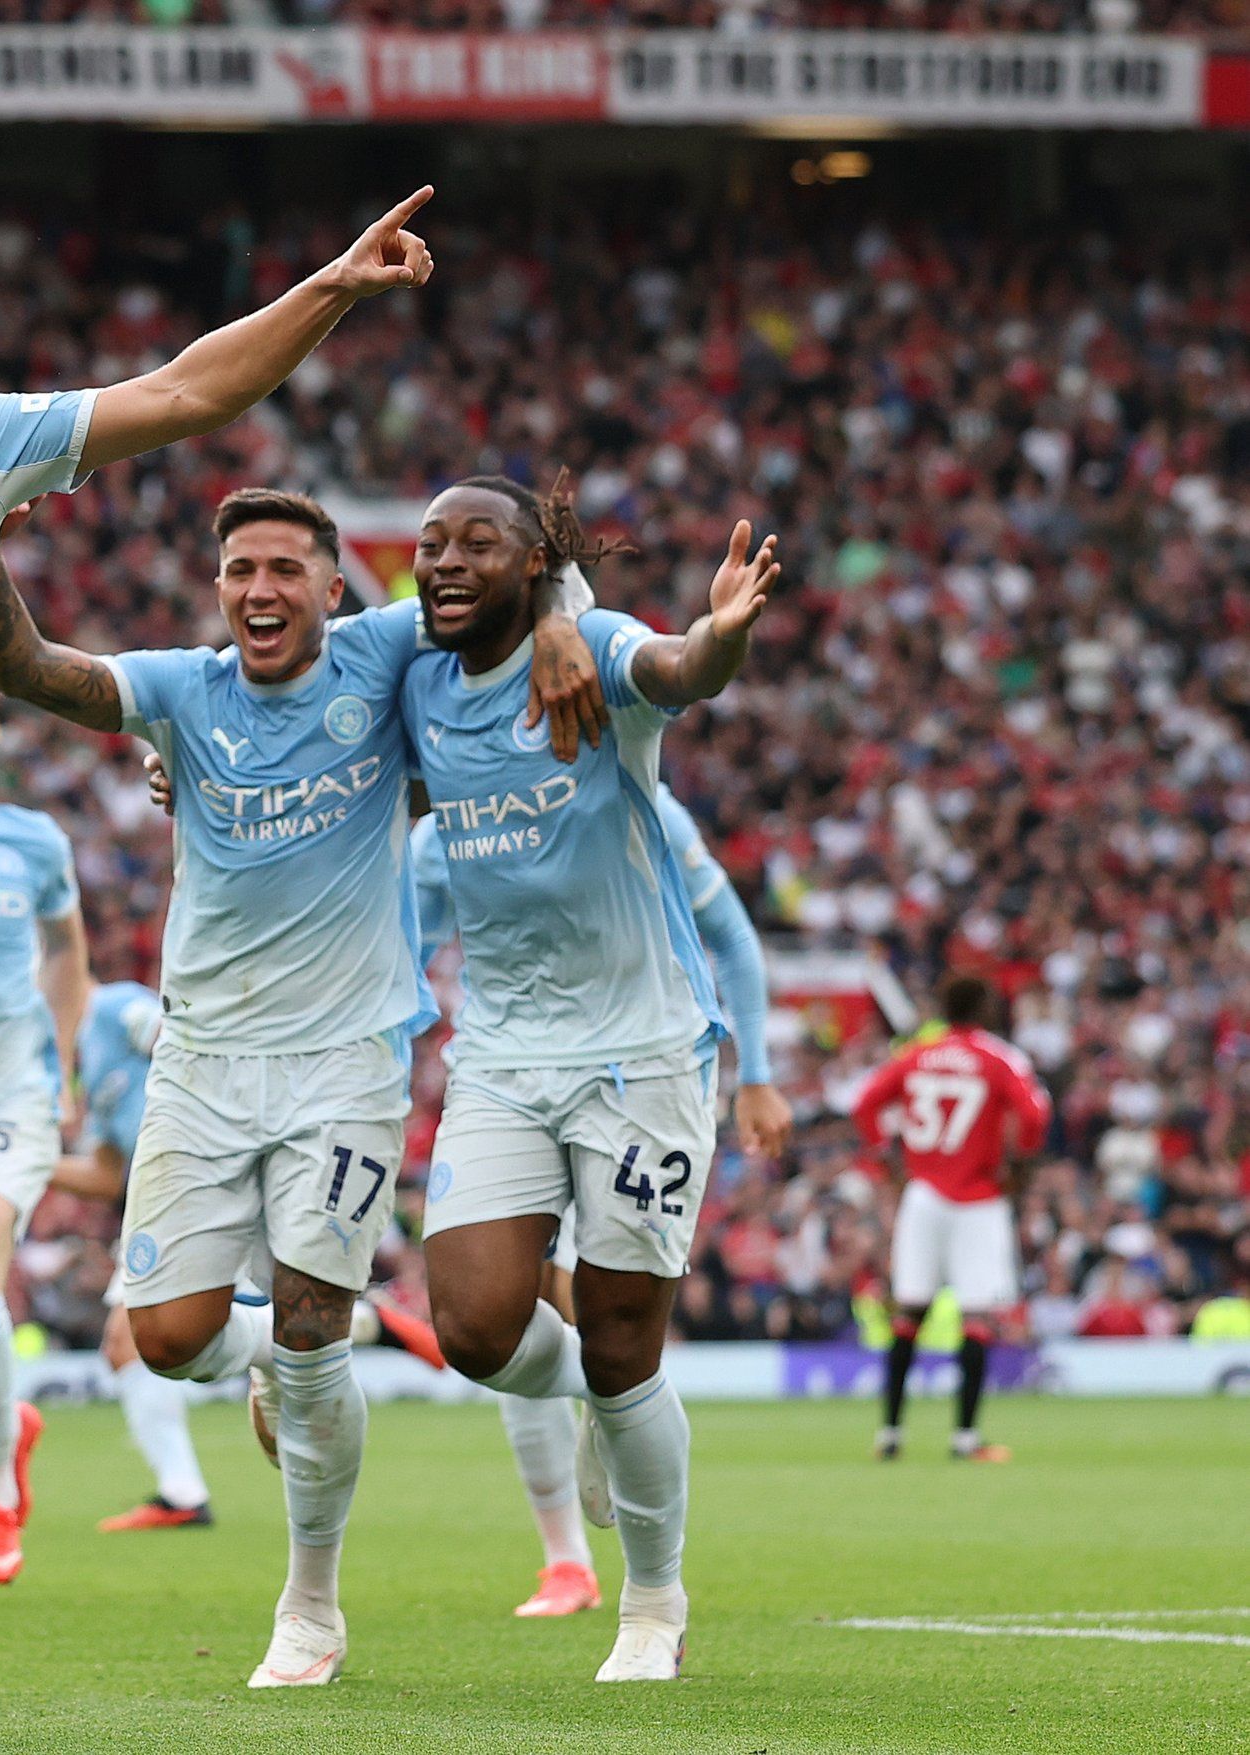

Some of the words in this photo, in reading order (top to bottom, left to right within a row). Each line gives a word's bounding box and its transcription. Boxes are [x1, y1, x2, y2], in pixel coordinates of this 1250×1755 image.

[199, 754, 381, 816] ETIHAD
[430, 775, 578, 831] TIHAD
[231, 807, 347, 841] AIRWAYS
[448, 826, 542, 861] AIRWAYS
[903, 1070, 989, 1155] 37
[324, 1144, 387, 1224] 17
[614, 1144, 692, 1217] 42
